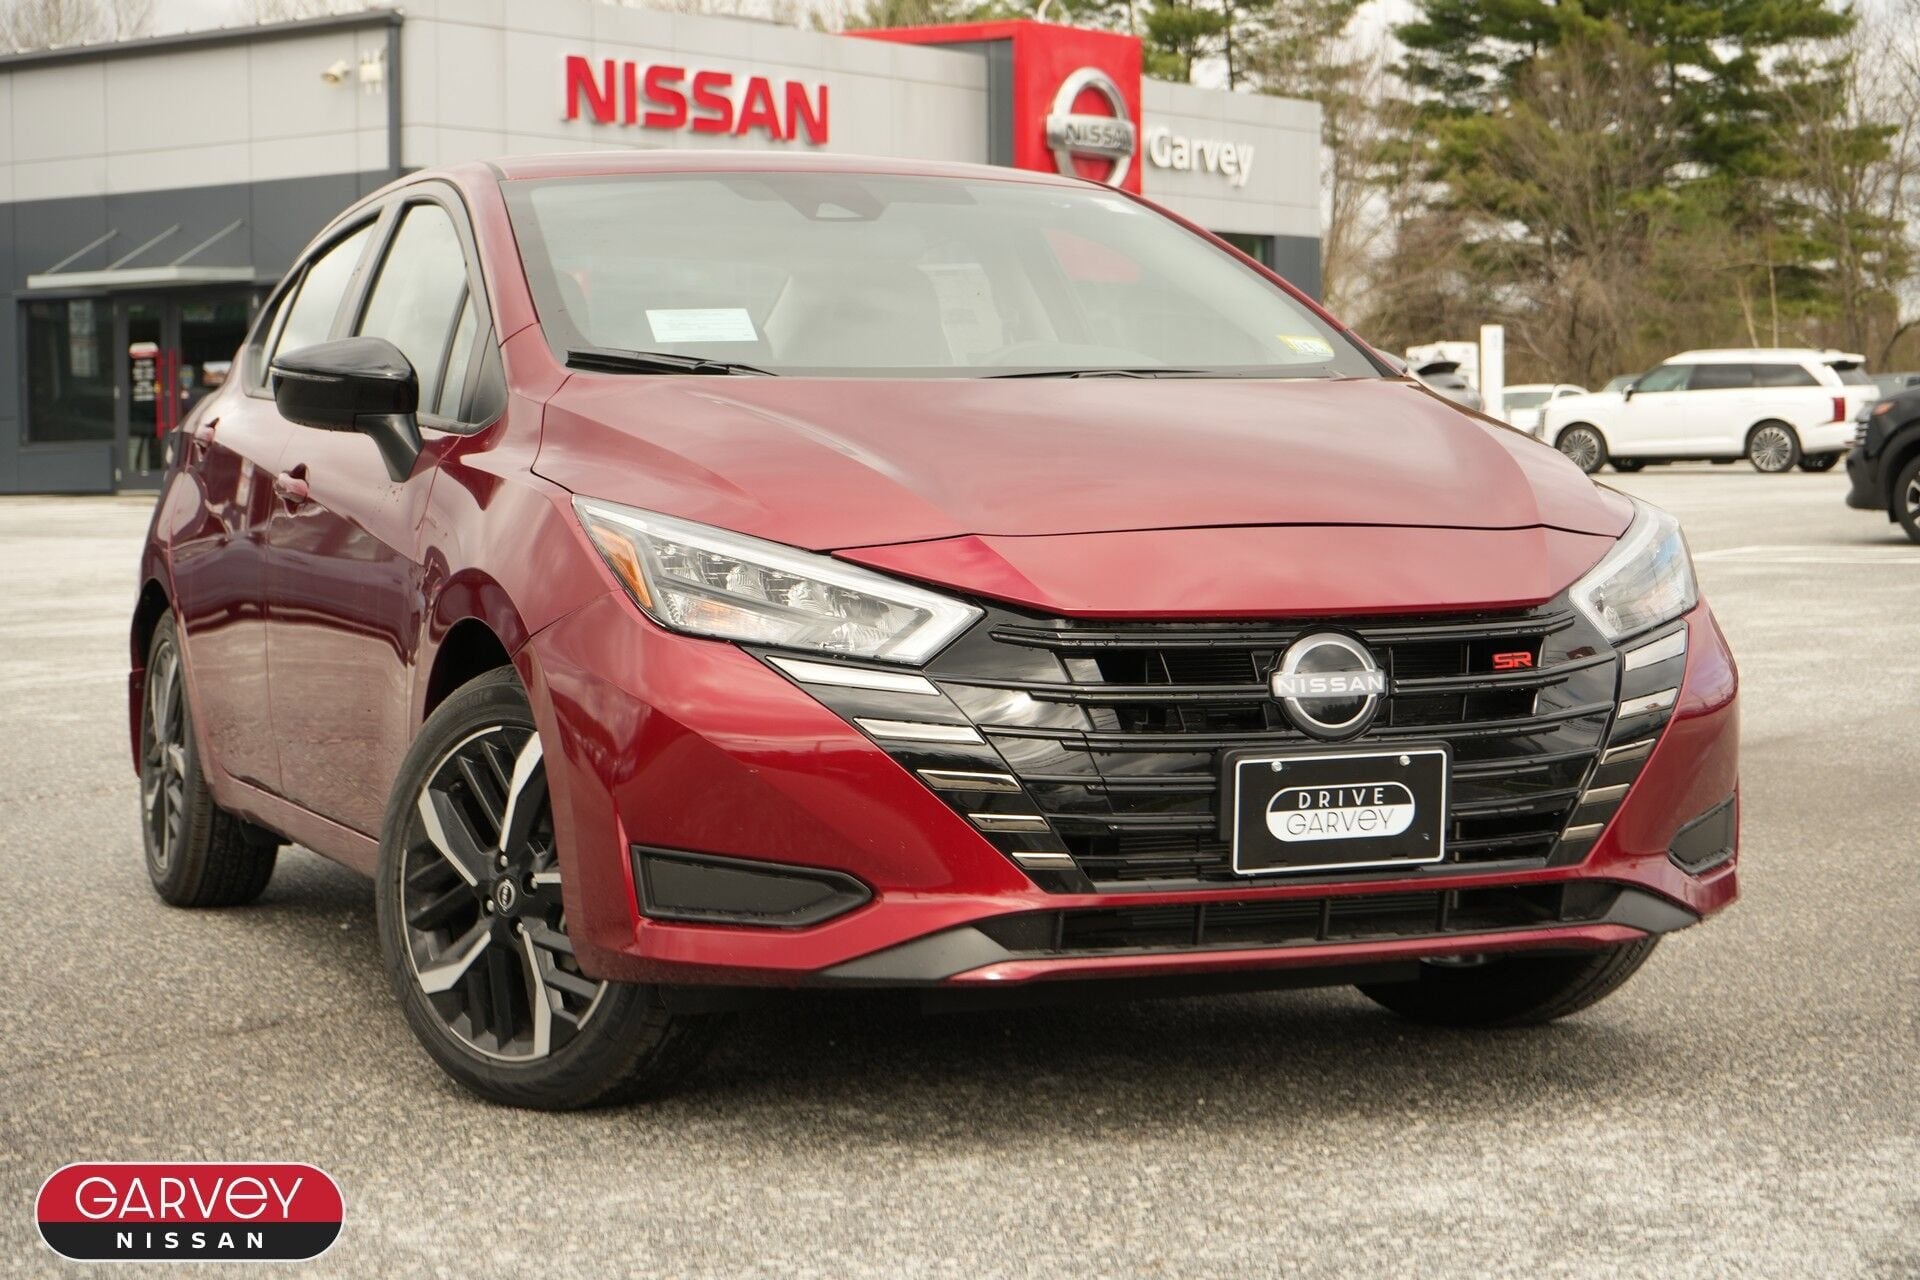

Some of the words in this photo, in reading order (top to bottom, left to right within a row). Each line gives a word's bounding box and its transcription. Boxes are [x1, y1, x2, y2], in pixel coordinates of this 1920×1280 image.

[566, 55, 828, 144] NISSAN
[1150, 127, 1254, 186] Garvey
[1493, 652, 1533, 669] SR
[1277, 675, 1383, 694] NISSAN
[1298, 787, 1384, 809] DRIVE
